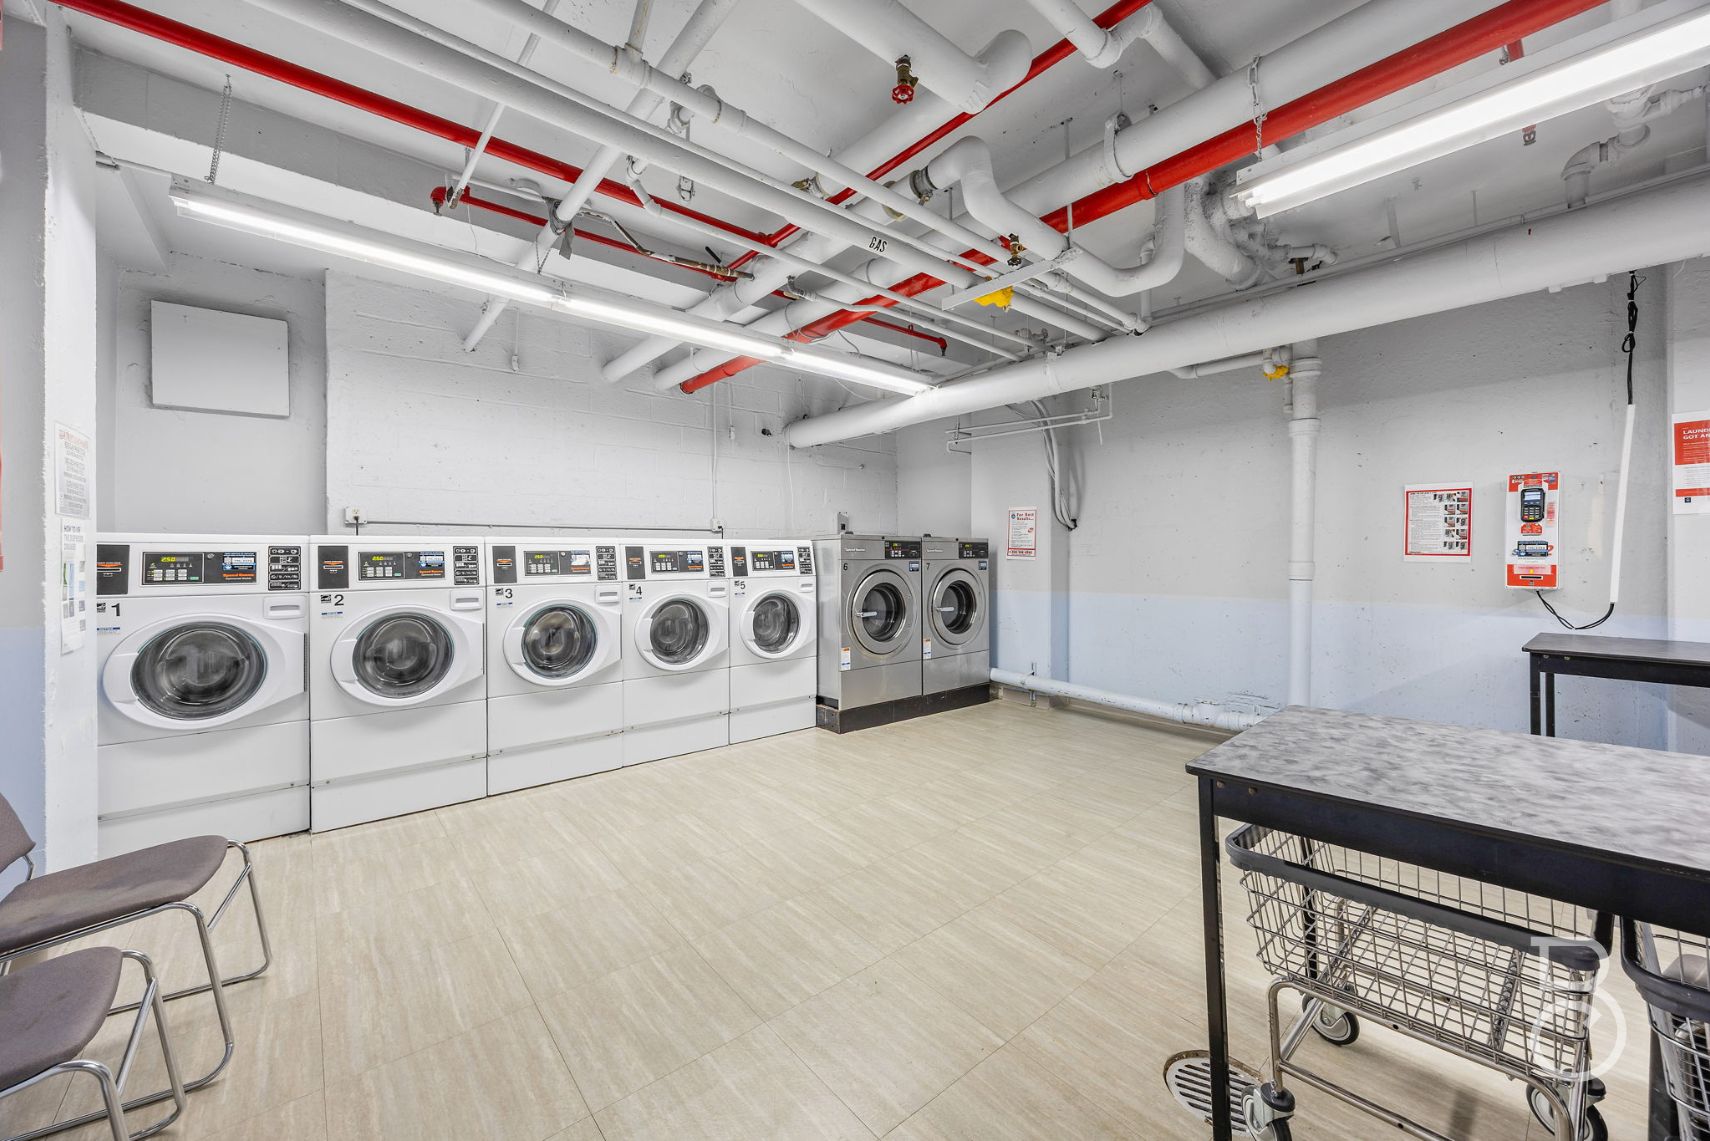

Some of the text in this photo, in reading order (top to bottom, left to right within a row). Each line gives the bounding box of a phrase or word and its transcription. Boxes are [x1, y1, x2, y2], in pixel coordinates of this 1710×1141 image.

[869, 236, 887, 252] GAS
[842, 562, 849, 571] 6
[926, 562, 931, 571] 7
[740, 581, 746, 590] 5
[504, 588, 513, 599] 3
[635, 586, 643, 596] 4
[334, 594, 344, 606] 2
[111, 603, 121, 617] 1
